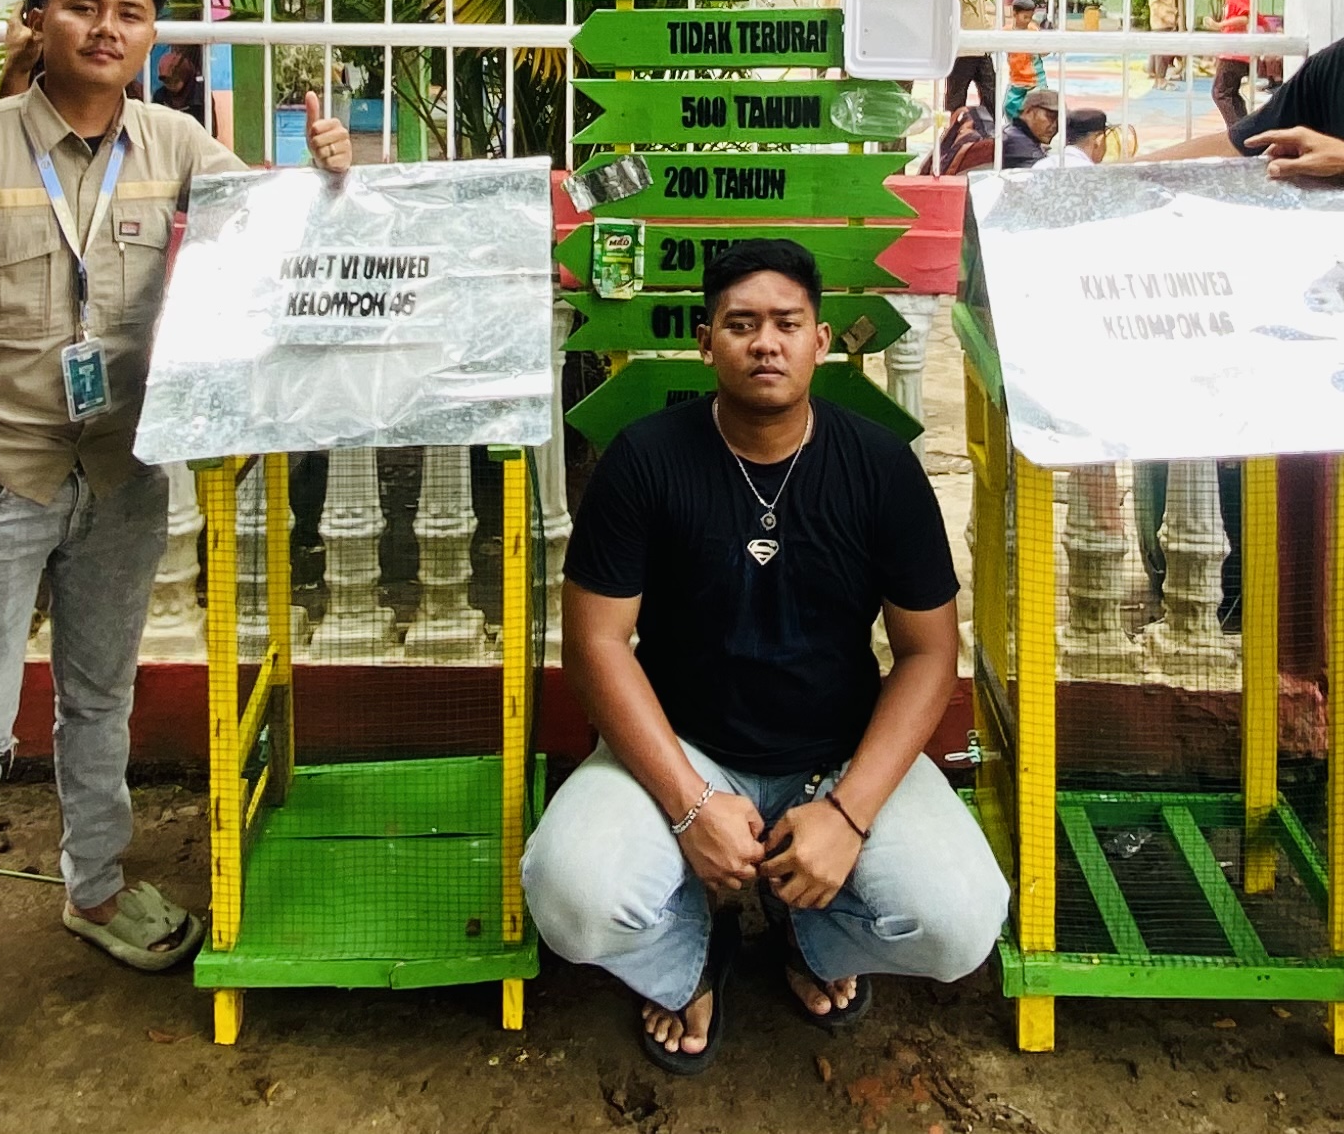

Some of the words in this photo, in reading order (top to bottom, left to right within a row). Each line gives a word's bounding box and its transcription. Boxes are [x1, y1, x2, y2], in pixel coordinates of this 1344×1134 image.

[667, 21, 734, 55] TIDAK
[736, 19, 828, 54] TERURAI
[681, 96, 727, 129] 500
[734, 96, 821, 129] TAHUN
[664, 166, 709, 199] 200
[713, 167, 786, 199] TAHUN
[280, 254, 337, 280] KKN-T
[340, 254, 360, 280] VI
[363, 254, 430, 280] UNIVED
[660, 237, 696, 272] 20
[1079, 273, 1137, 300] KKN-T
[1138, 273, 1162, 299] VI
[1163, 270, 1234, 299] UNIVED
[286, 291, 388, 317] KELOMPOK
[652, 304, 684, 338] 01
[1102, 311, 1207, 340] KELOMPOK
